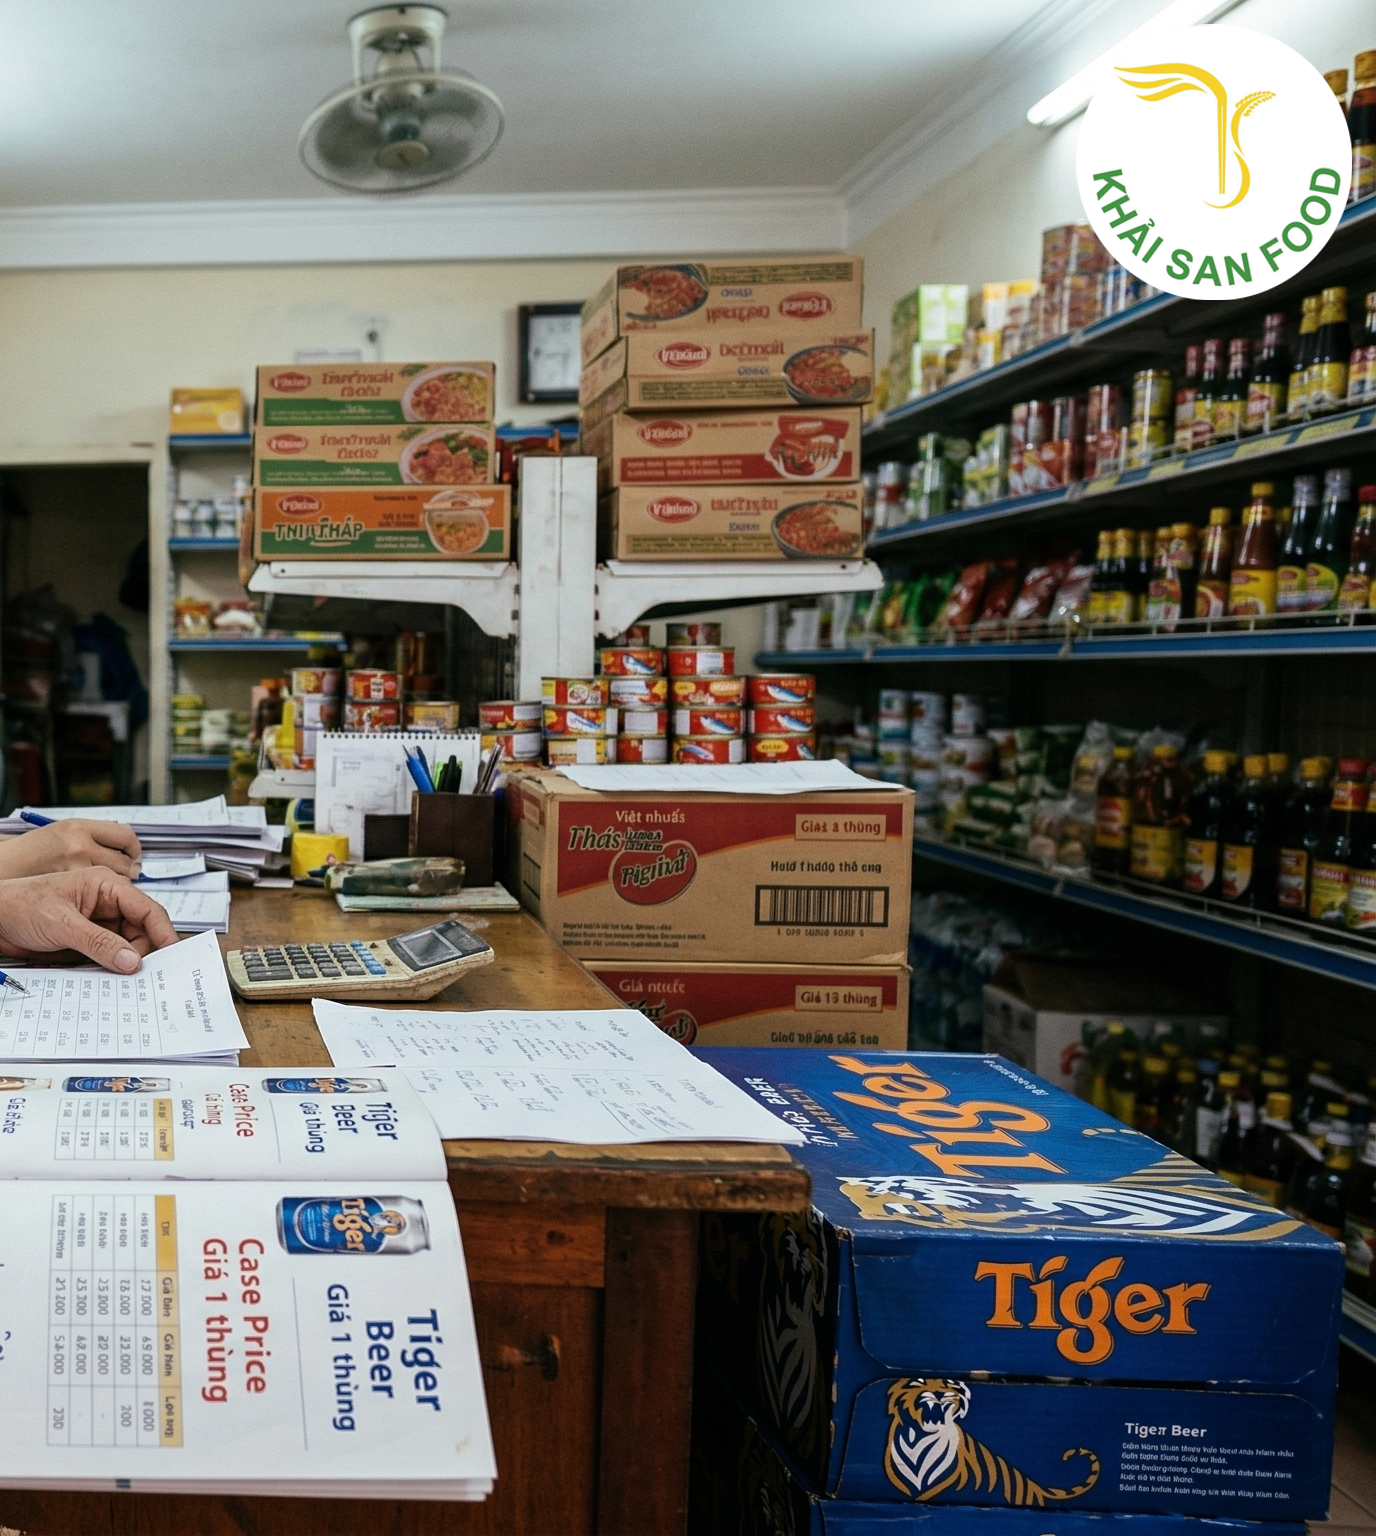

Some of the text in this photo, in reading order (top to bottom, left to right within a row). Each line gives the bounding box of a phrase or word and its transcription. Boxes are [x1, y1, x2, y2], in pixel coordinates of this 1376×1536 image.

[827, 1055, 1069, 1179] Tiger
[201, 1237, 234, 1403] Giá 1 thùng
[237, 1237, 272, 1394] Case Price
[326, 1283, 360, 1433] Giá 1 thùng
[365, 1320, 395, 1400] Beer
[973, 1255, 1213, 1366] Tiger
[1171, 1424, 1208, 1438] Beer
